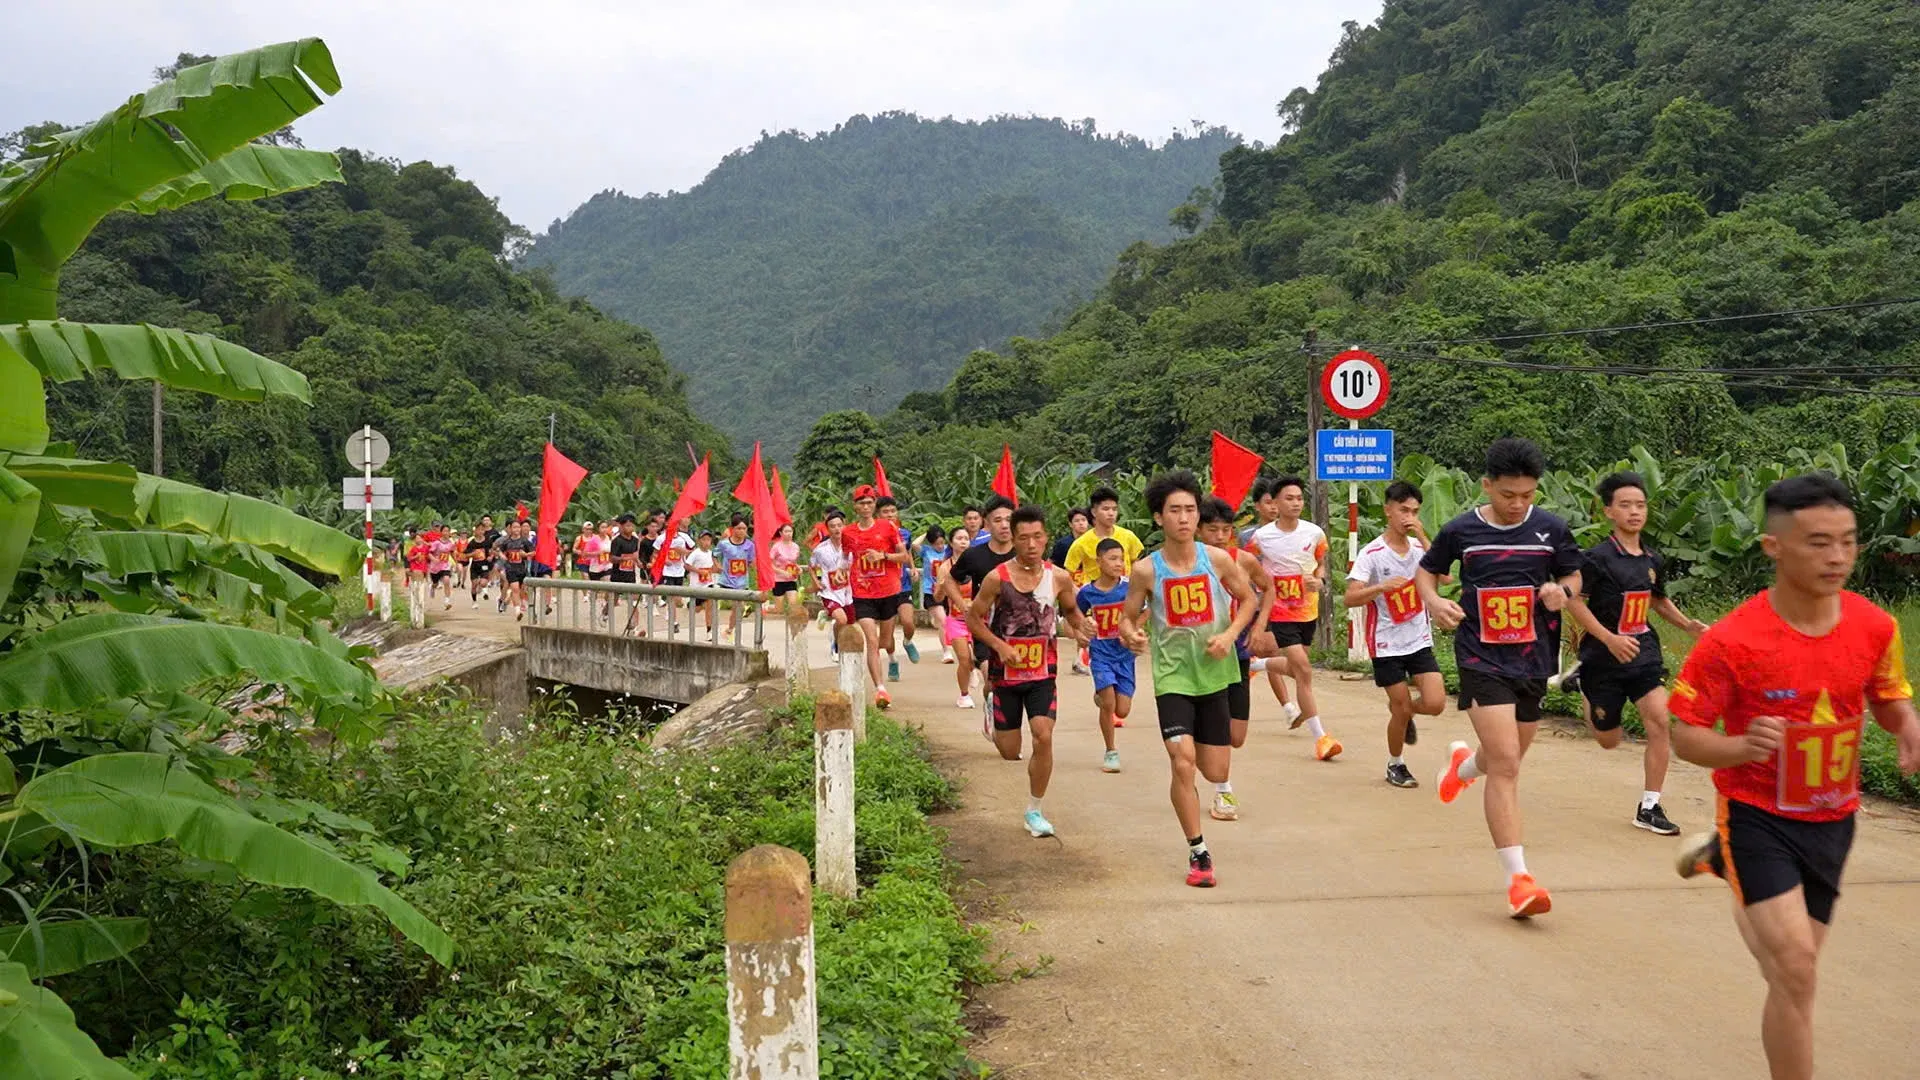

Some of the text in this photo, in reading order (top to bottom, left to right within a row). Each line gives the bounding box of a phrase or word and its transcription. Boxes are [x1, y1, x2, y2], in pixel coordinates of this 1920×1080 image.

[1170, 582, 1208, 615] 05
[1277, 579, 1302, 599] 34
[1390, 584, 1416, 613] 17
[1487, 596, 1528, 630] 35
[1797, 730, 1857, 788] 15
